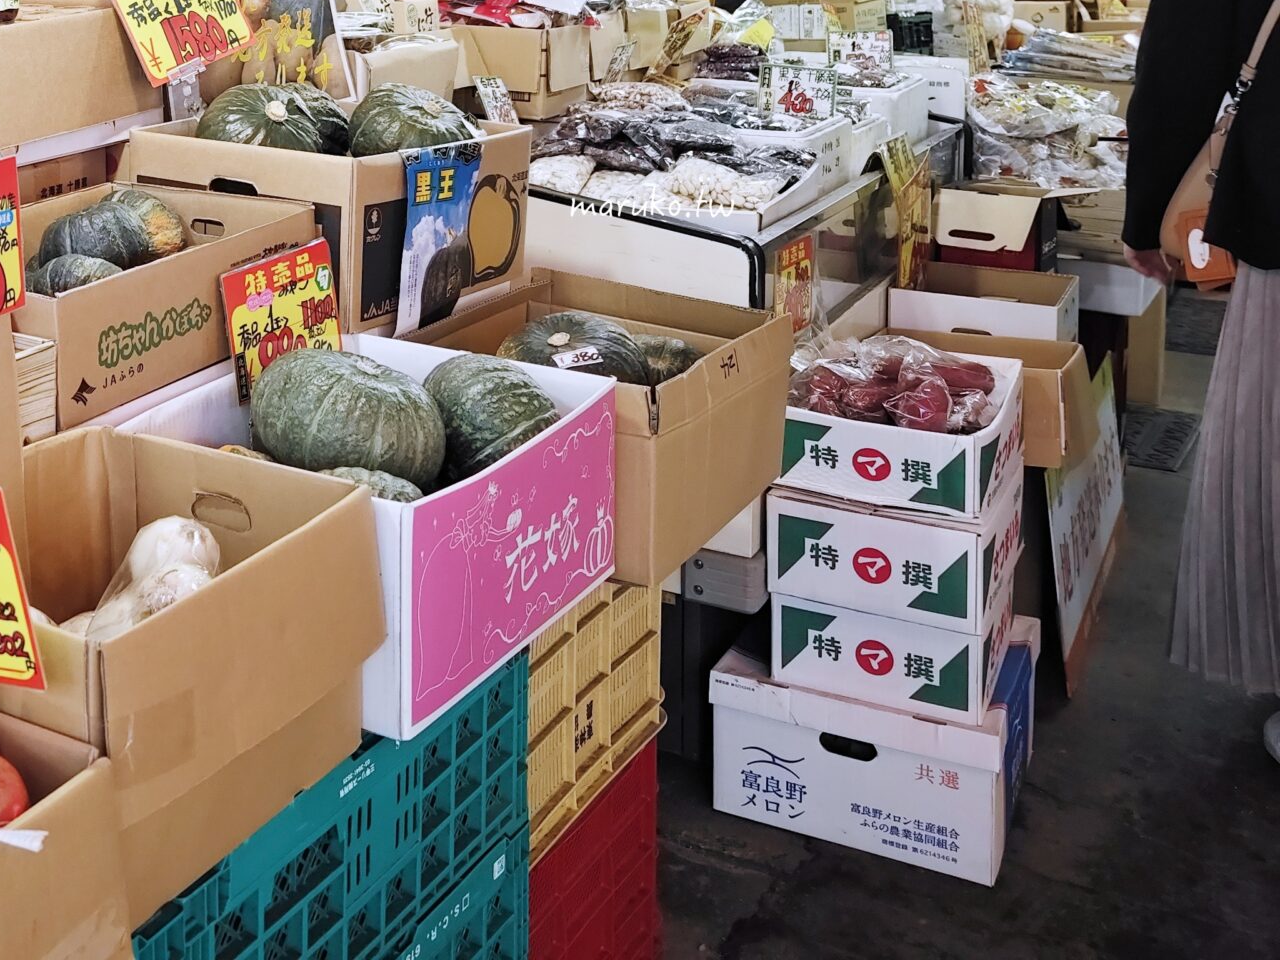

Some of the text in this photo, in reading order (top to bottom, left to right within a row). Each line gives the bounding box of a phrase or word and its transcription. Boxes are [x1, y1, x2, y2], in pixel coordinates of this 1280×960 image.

[160, 10, 229, 67] 1580
[244, 252, 315, 296] 特売品
[97, 297, 212, 369] 坊ちゃんかぼちゃ
[102, 362, 145, 389] JAふらの
[809, 443, 932, 485] 特 マ 撰
[505, 493, 581, 604] 花嫁
[810, 542, 933, 590] 特 マ 撰
[813, 634, 935, 682] 特 マ 撰
[740, 769, 807, 803] 富良野
[915, 763, 960, 791] 共選
[740, 792, 806, 819] メロン
[850, 802, 961, 839] 富良野メロン生産組合
[860, 818, 960, 853] ふらの農業協同組合
